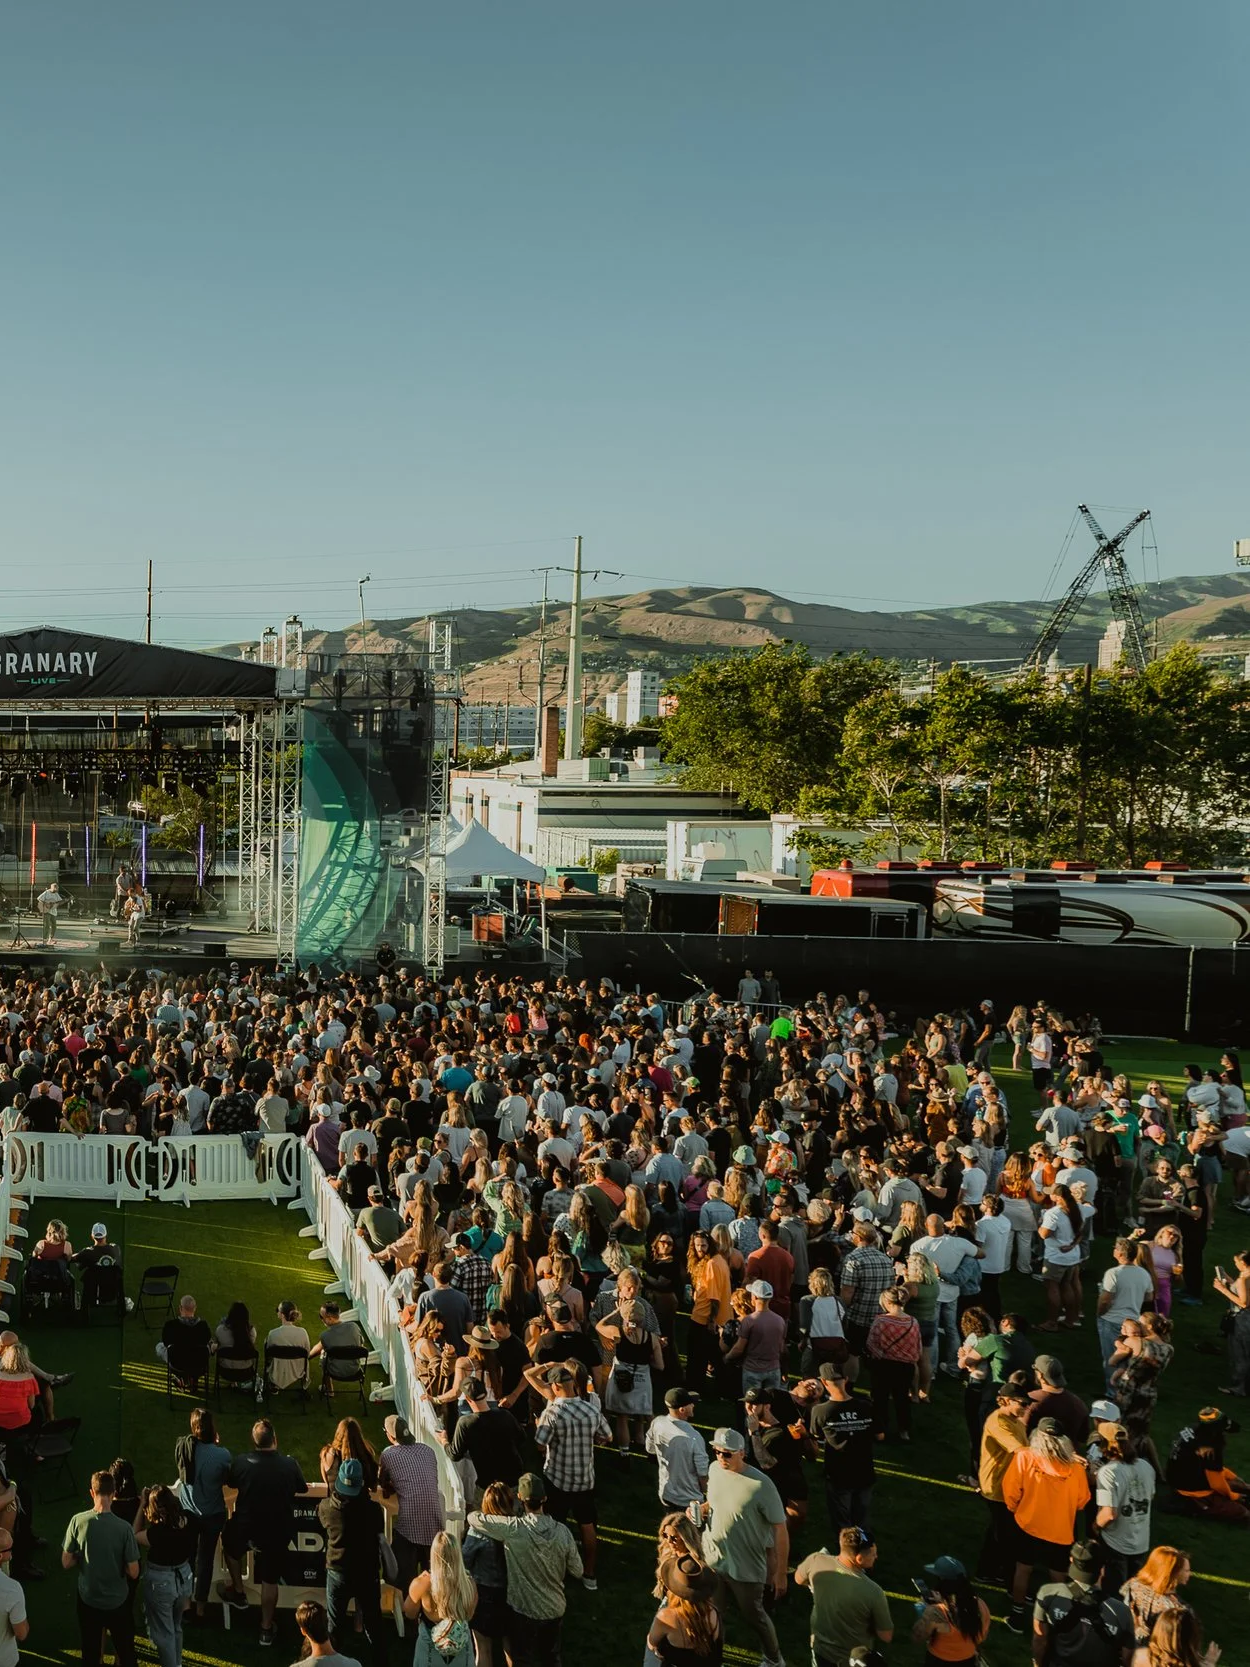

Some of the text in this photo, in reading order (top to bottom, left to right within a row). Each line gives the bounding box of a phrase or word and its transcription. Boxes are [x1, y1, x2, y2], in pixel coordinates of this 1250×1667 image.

[30, 677, 56, 685] LIVE
[840, 1411, 858, 1420] KRC
[293, 1509, 317, 1518] GRANA
